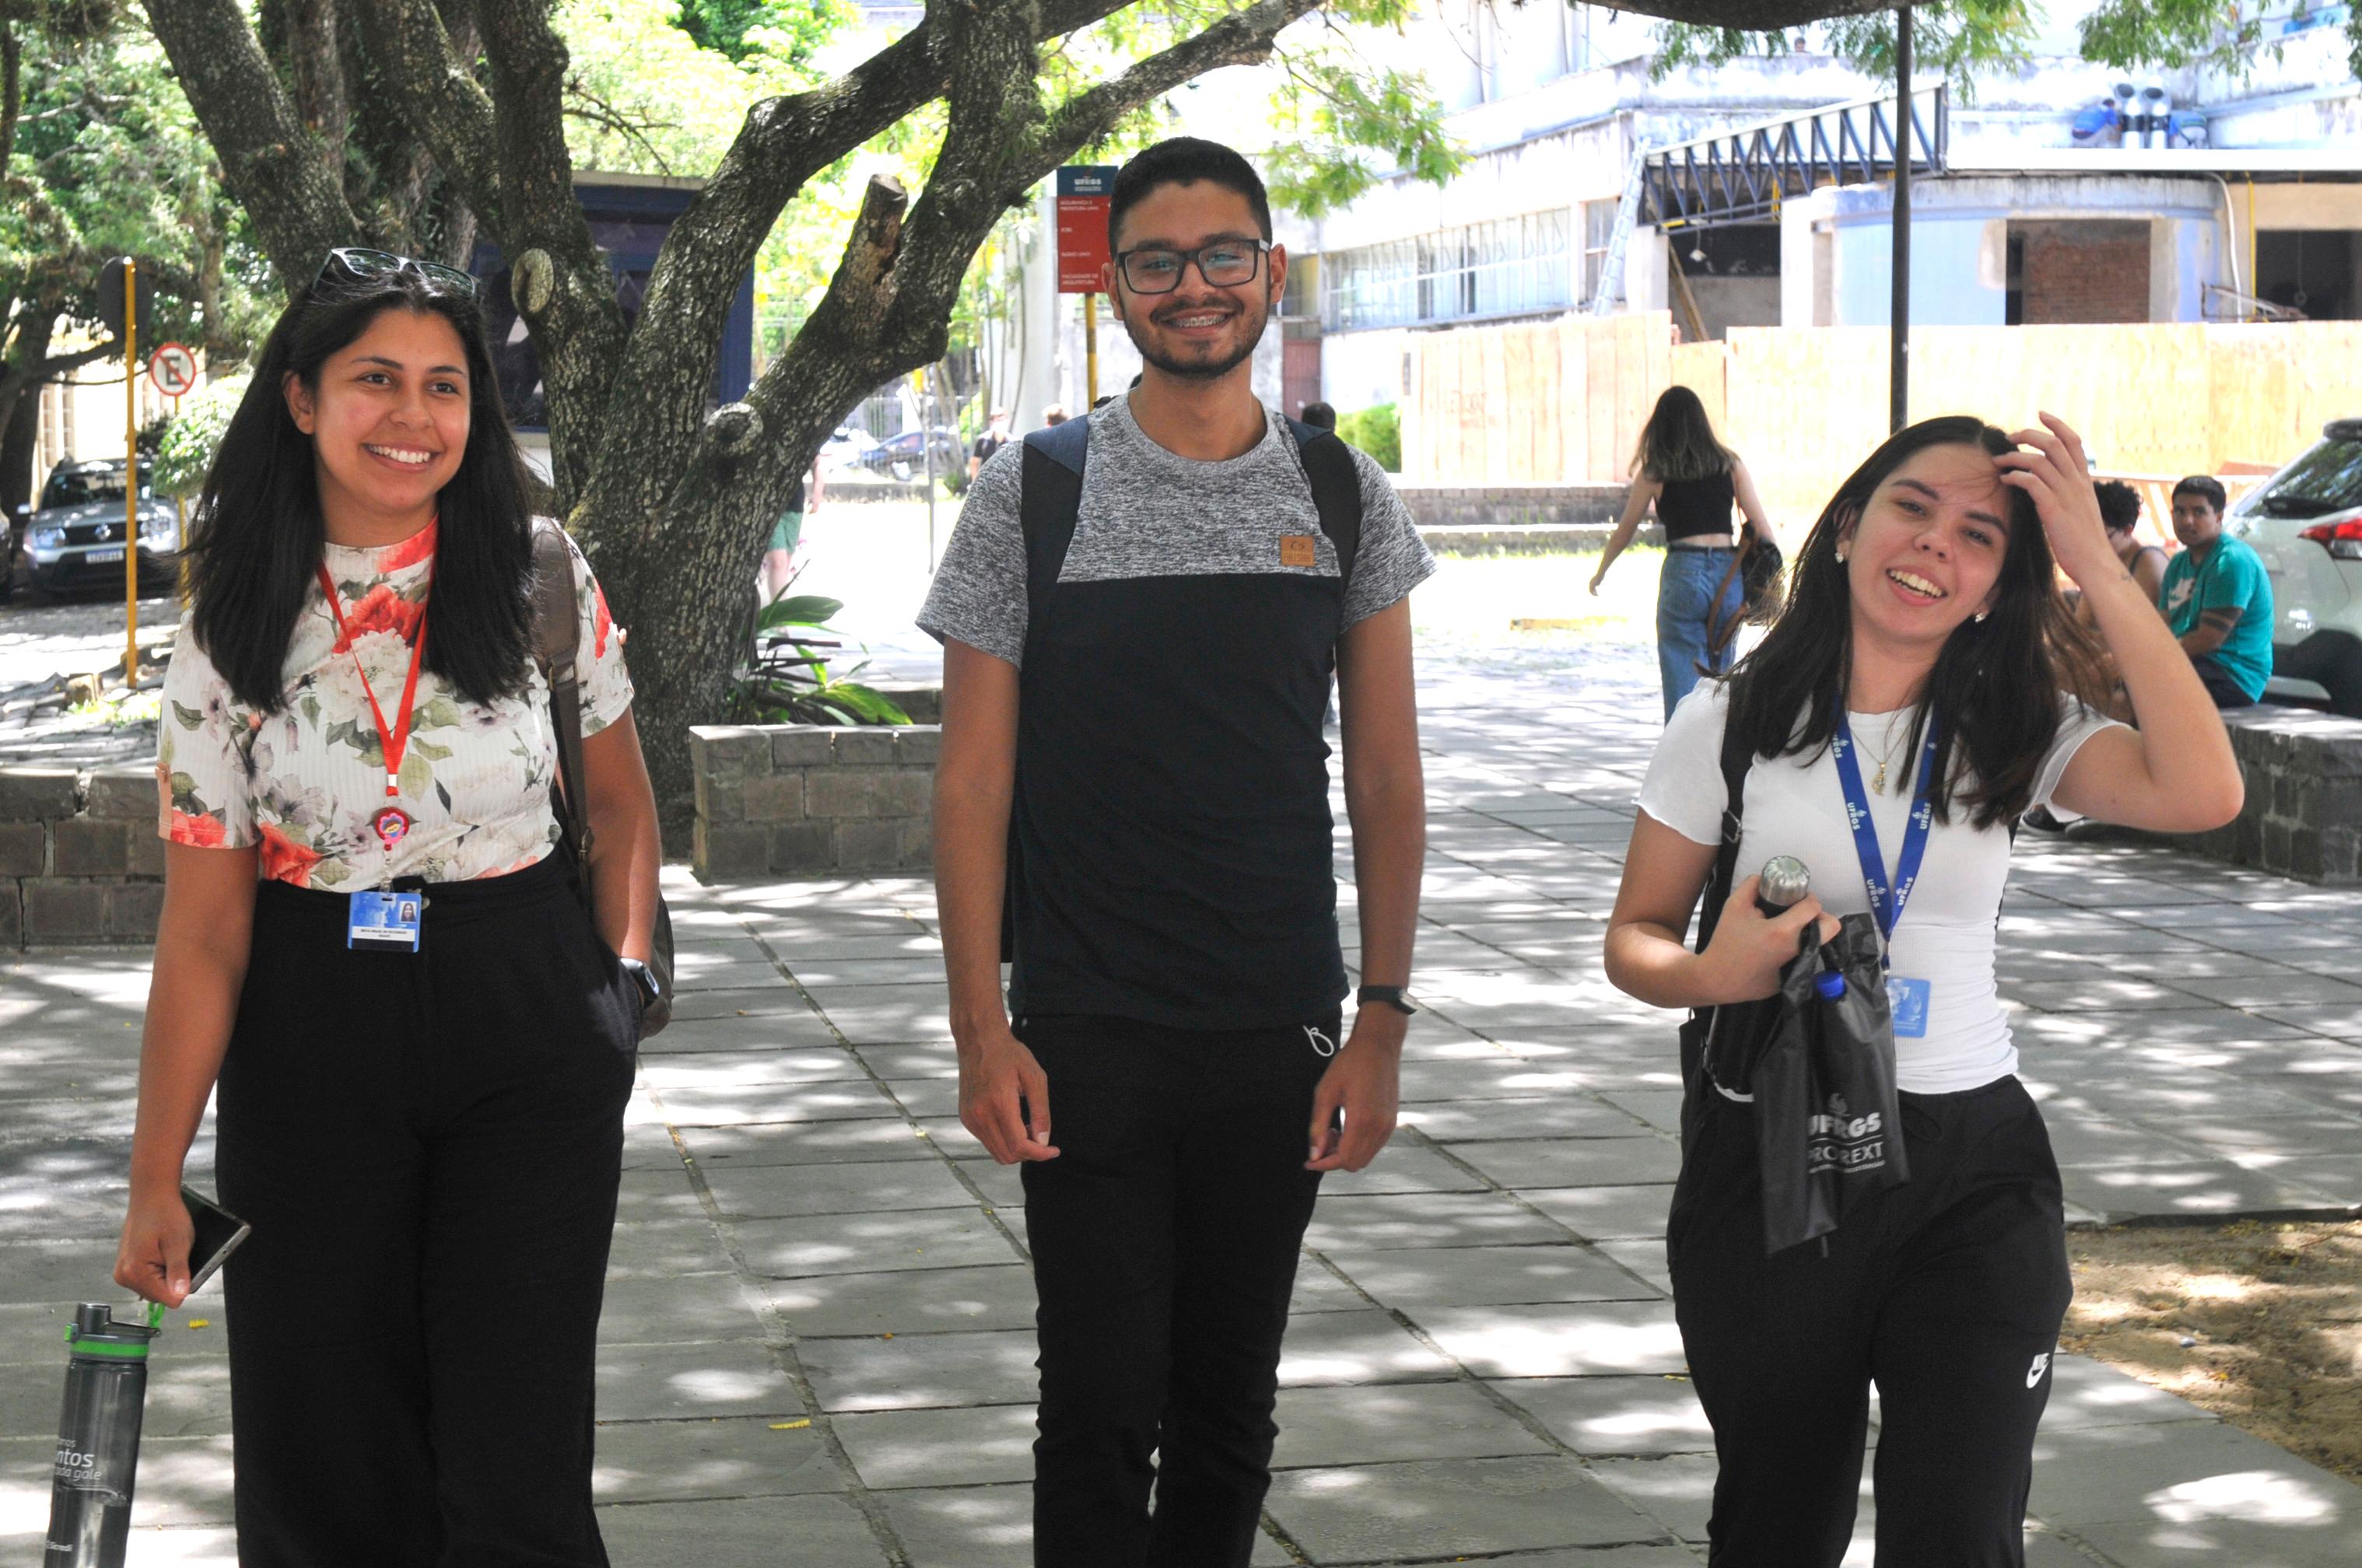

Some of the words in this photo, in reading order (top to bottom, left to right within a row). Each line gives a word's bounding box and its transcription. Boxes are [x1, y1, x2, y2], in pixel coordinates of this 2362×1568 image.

[1847, 802, 1861, 831] UFRGS
[1919, 802, 1932, 830] UFRGS
[1866, 879, 1881, 908] UFRGS
[1898, 877, 1914, 906] UFRGS
[73, 1469, 102, 1482] gole
